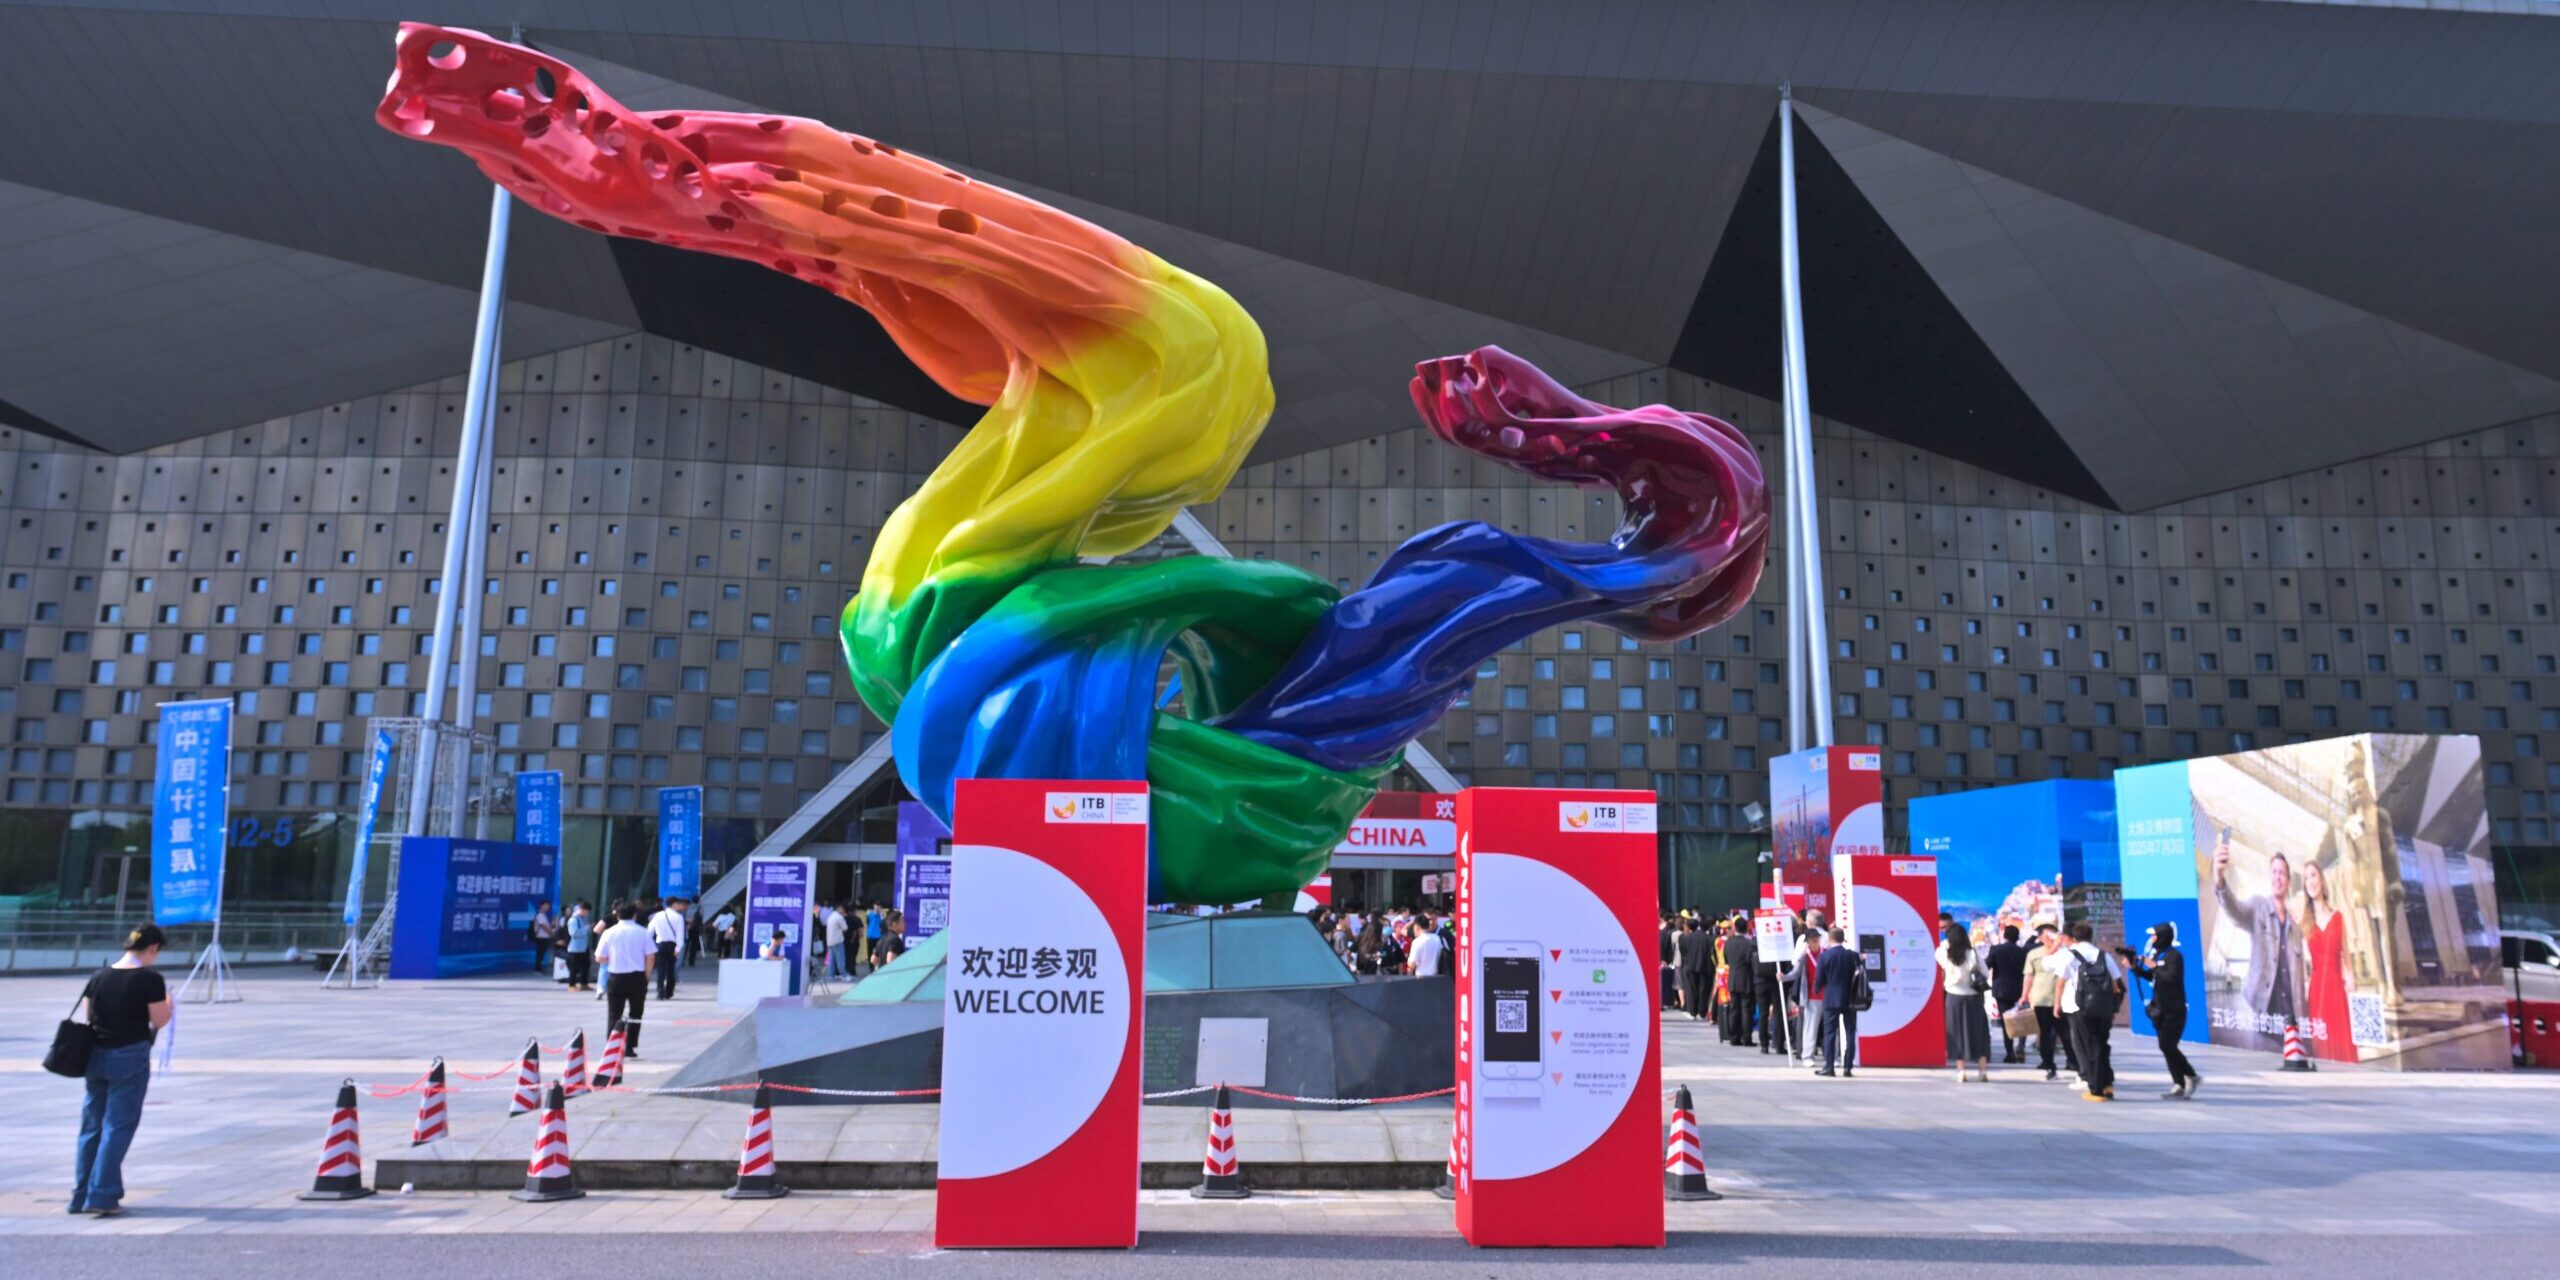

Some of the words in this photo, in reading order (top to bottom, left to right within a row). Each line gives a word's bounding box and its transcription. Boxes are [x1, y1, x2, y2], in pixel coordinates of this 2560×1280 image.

[1082, 797, 1105, 809] ITB
[1594, 807, 1616, 818] ITB
[1081, 811, 1105, 820] CHINA
[1594, 820, 1616, 829] CHINA
[1346, 826, 1427, 847] CHINA
[1460, 831, 1469, 977] CHINA
[961, 946, 1097, 979] 欢迎参观
[954, 989, 1105, 1014] WELCOME
[1460, 994, 1469, 1063] ITB
[1460, 1081, 1469, 1196] 2025
